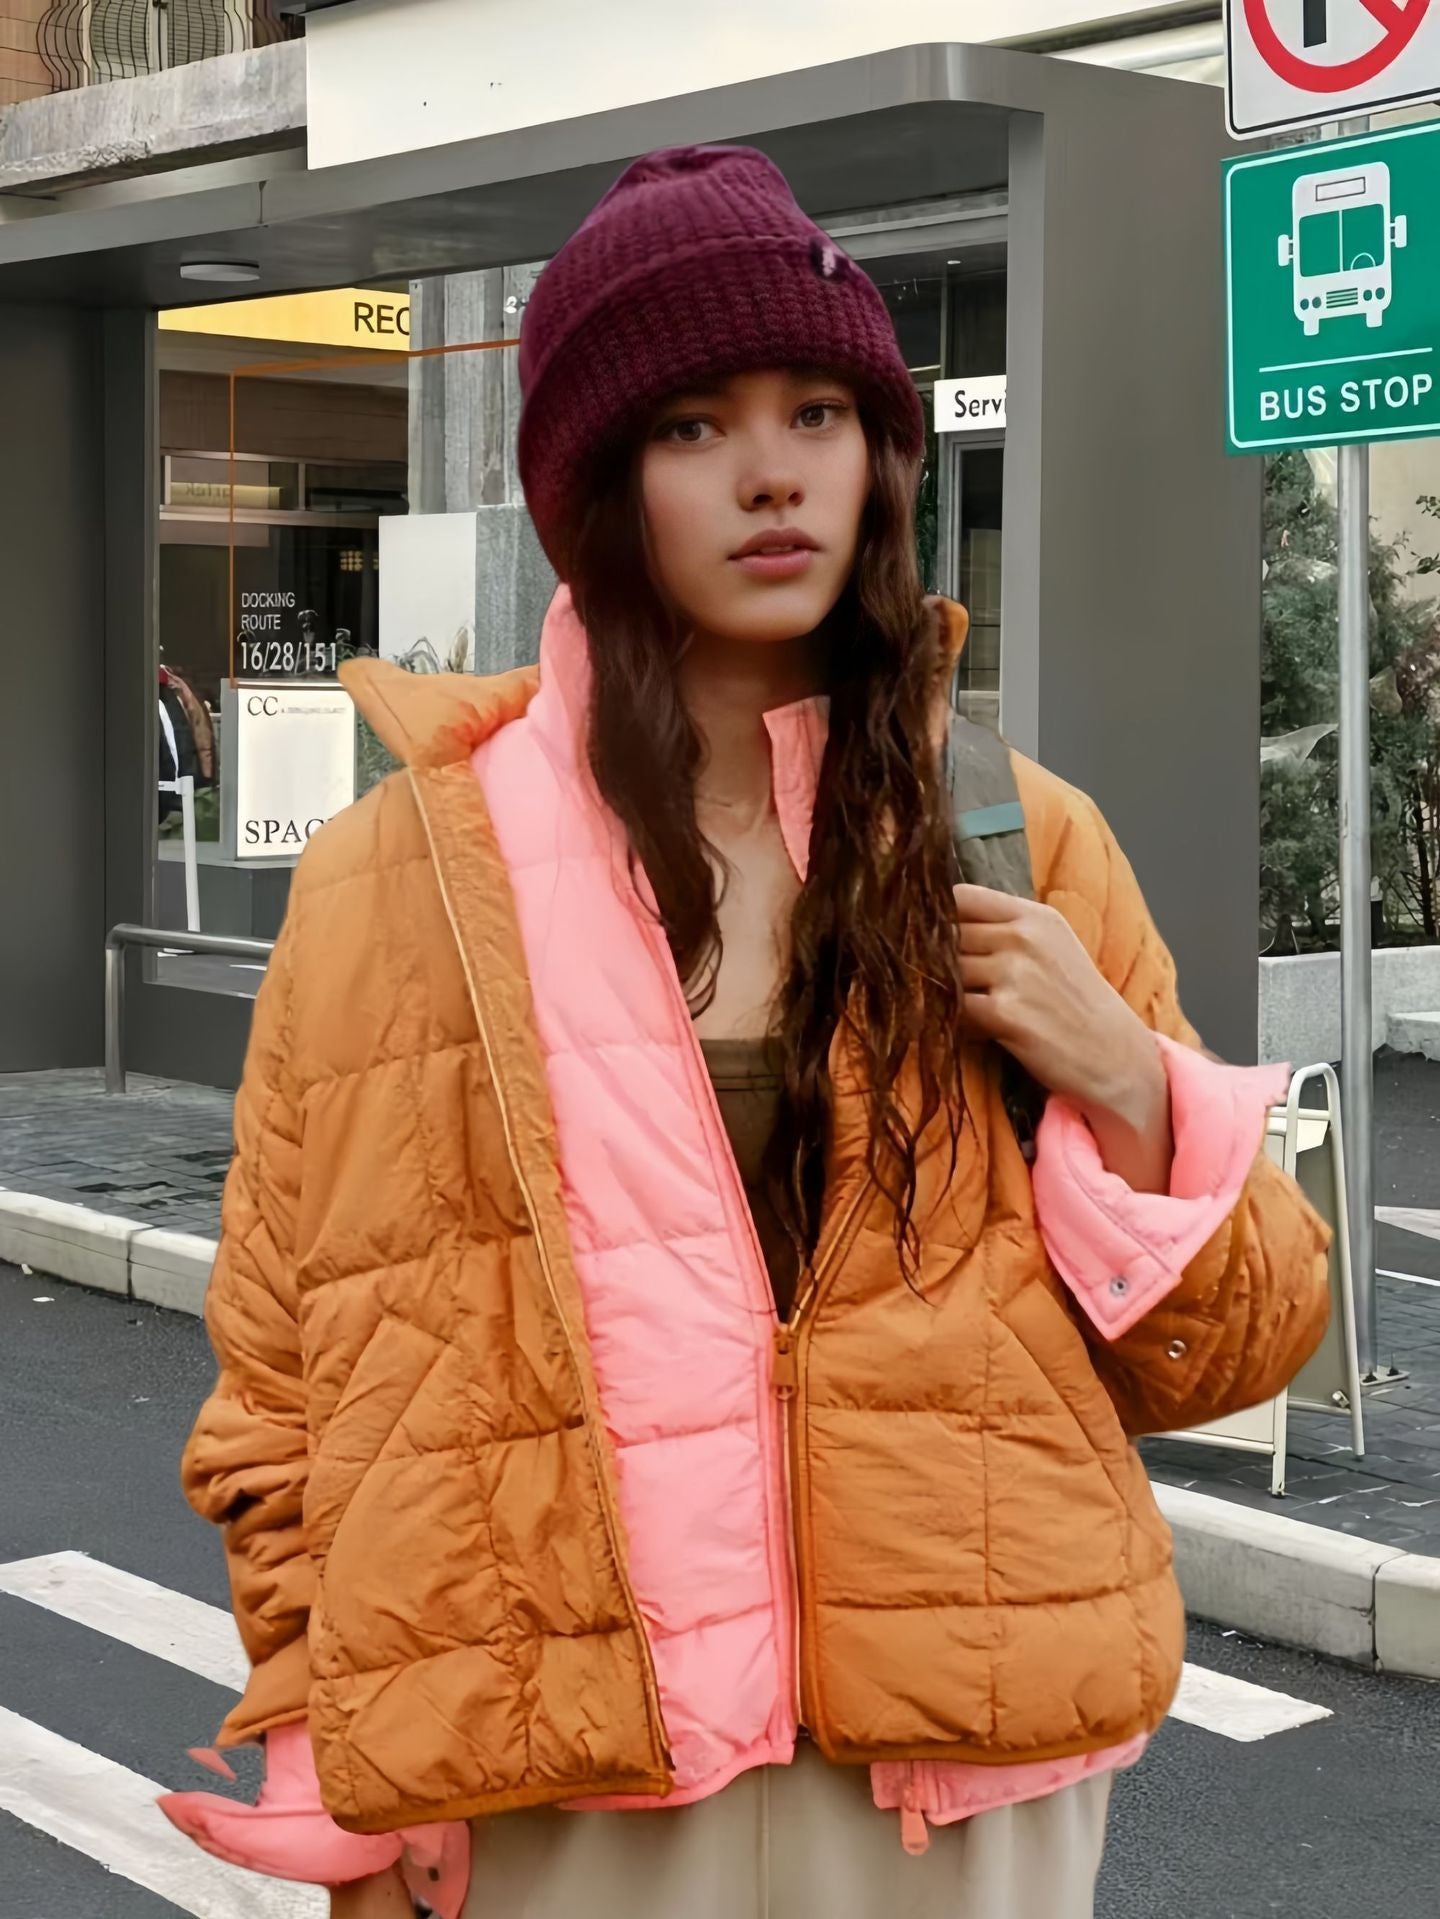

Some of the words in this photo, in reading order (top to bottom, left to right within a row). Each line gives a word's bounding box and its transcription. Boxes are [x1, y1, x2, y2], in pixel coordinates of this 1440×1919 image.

[1260, 385, 1327, 421] BUS
[1340, 373, 1433, 413] STOP
[241, 592, 296, 608] DOCKING
[241, 614, 281, 630] ROUTE
[241, 641, 337, 675] 16/28/151
[245, 818, 333, 844] SPAC
